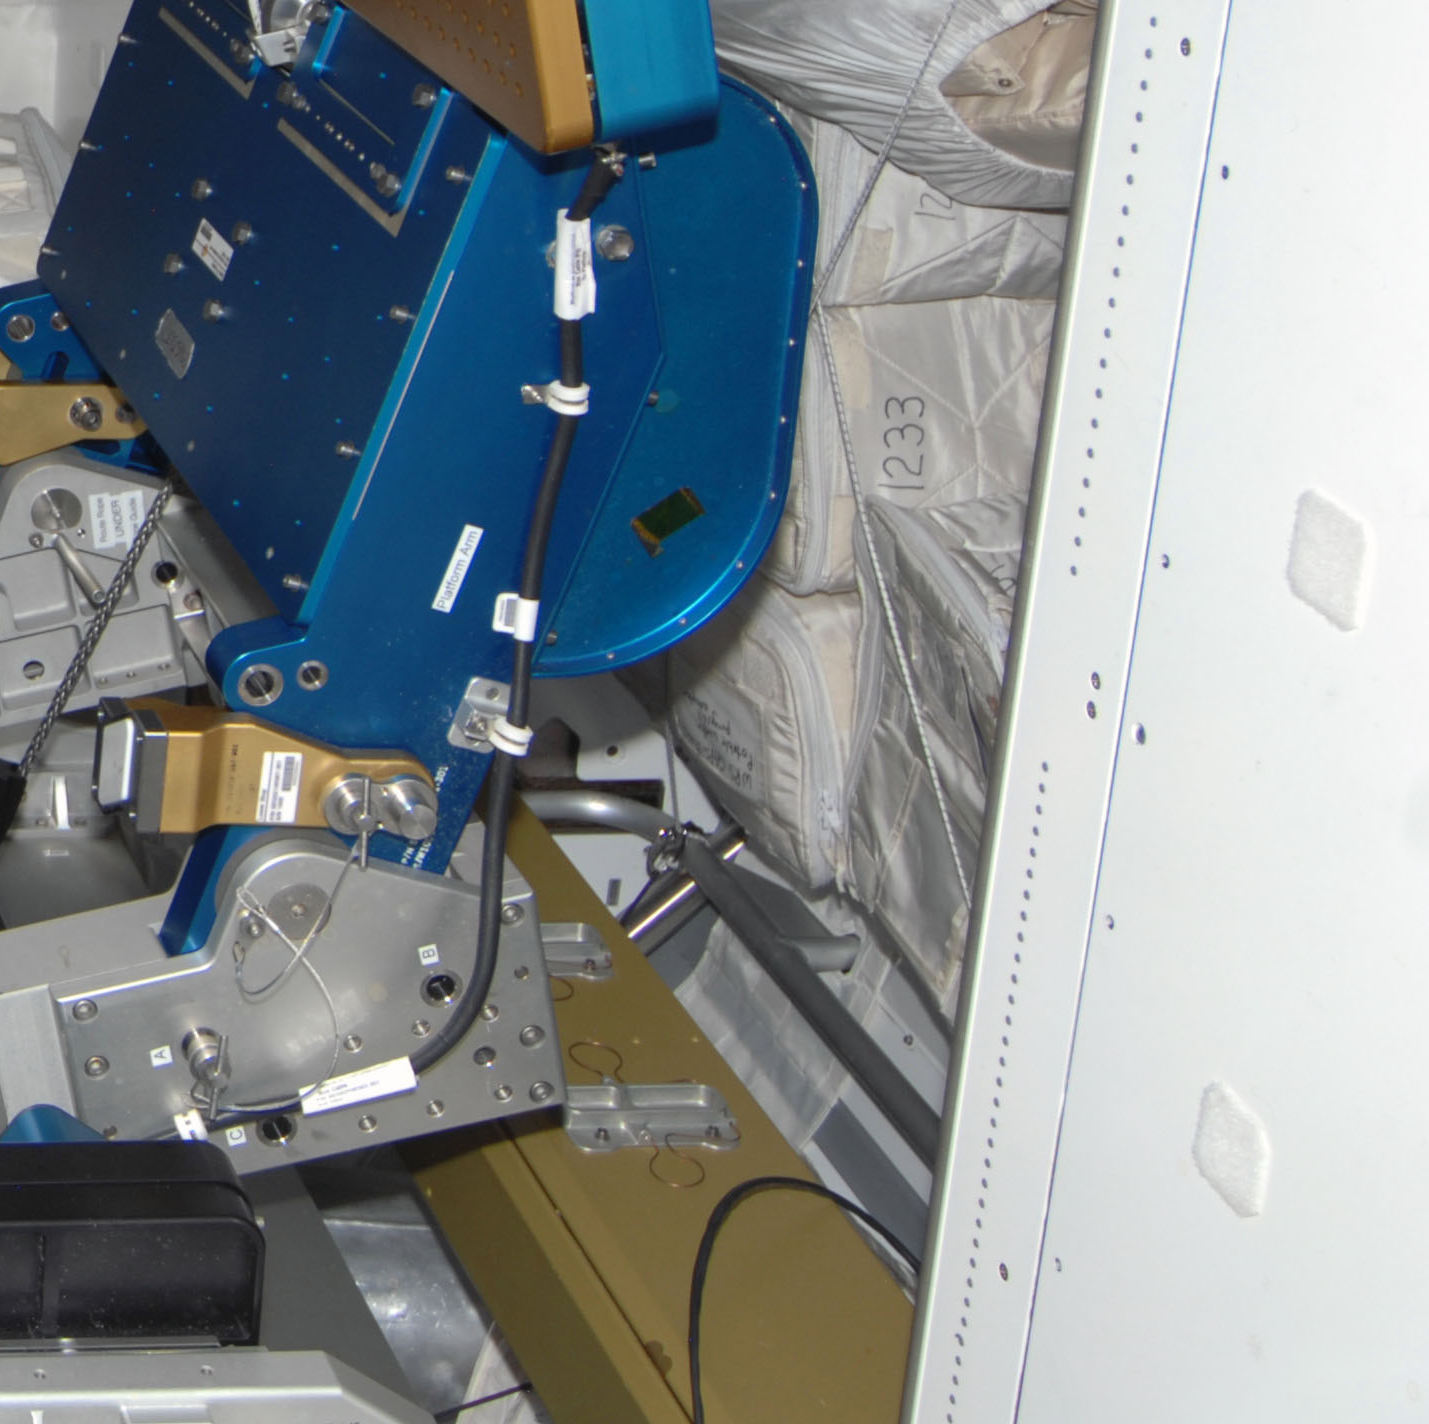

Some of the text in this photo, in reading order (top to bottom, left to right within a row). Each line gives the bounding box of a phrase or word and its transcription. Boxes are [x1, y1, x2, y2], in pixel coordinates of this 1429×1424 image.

[871, 393, 930, 492] 1233
[107, 499, 127, 538] UNDER
[435, 527, 479, 611] Platform Arm
[421, 947, 435, 958] B
[153, 1048, 167, 1058] A
[229, 1129, 243, 1140] C
